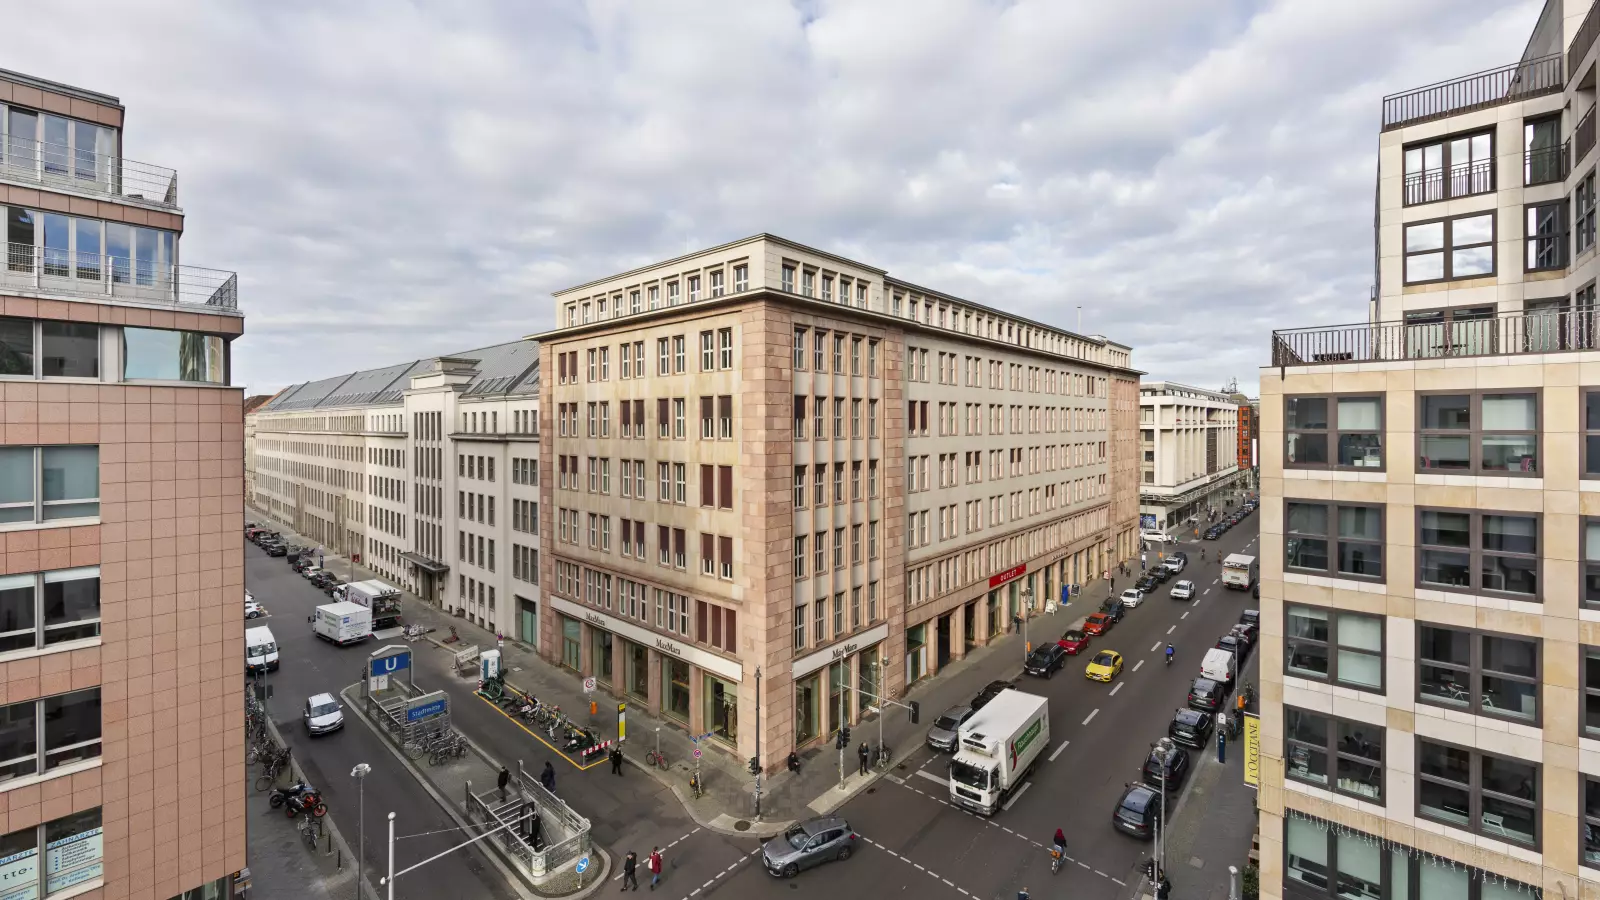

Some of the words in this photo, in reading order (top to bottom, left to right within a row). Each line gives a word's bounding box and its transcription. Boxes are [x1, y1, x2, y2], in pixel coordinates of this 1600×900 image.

[1000, 569, 1017, 581] OUTLET
[585, 611, 606, 626] MaxMara
[655, 638, 681, 655] MaxMara
[385, 657, 397, 671] U
[412, 704, 441, 717] Stadtmitte
[1247, 722, 1259, 779] L'OCCITANE
